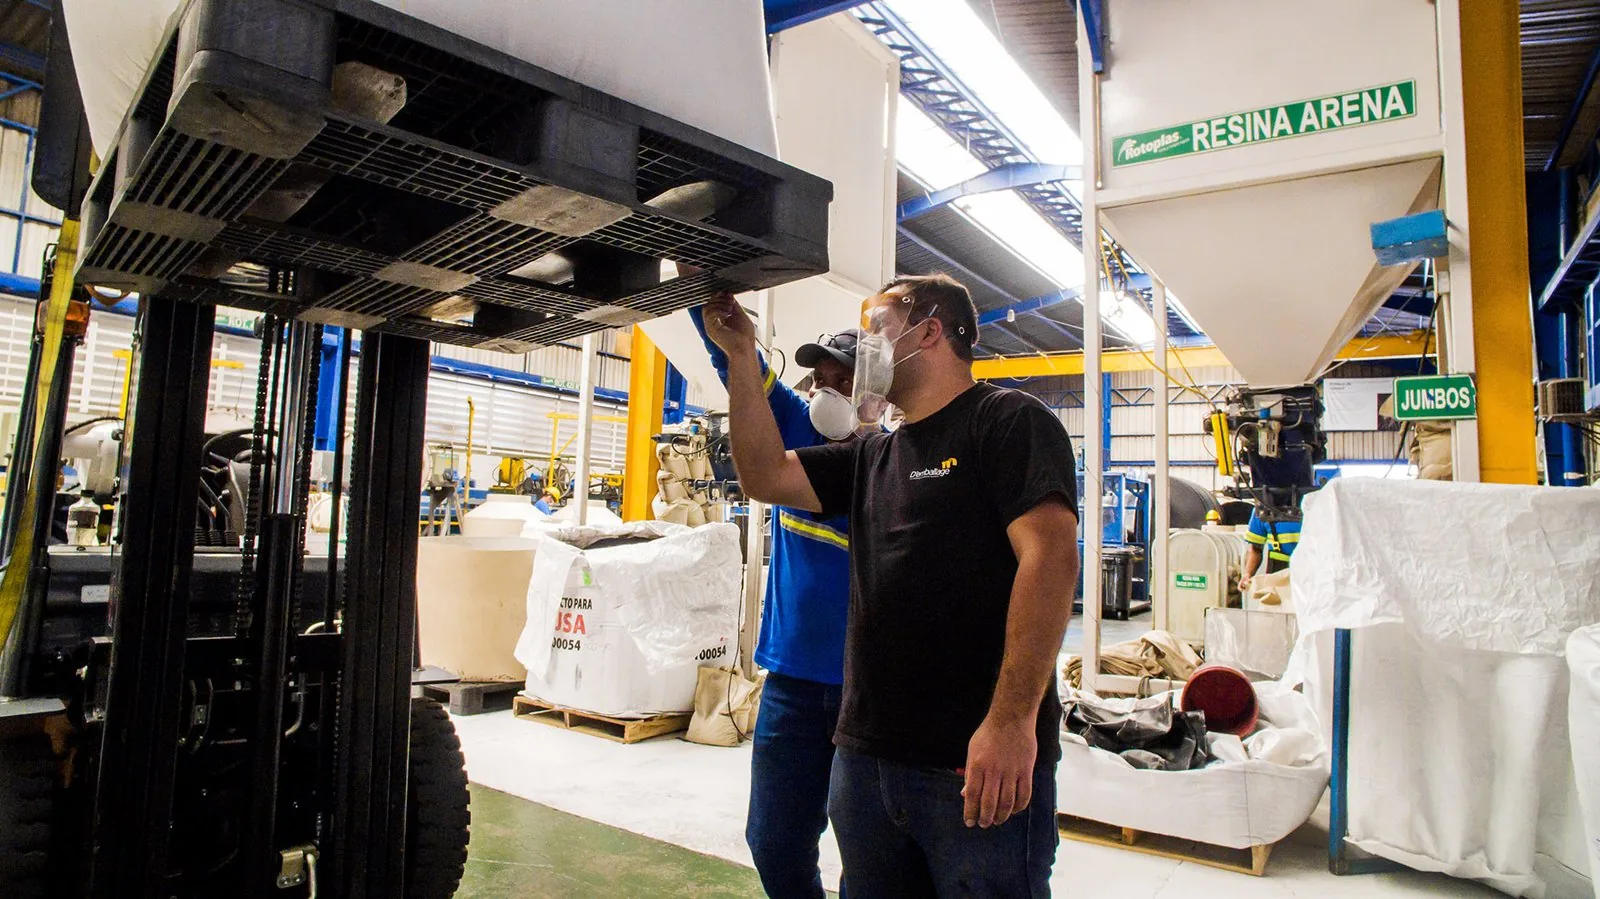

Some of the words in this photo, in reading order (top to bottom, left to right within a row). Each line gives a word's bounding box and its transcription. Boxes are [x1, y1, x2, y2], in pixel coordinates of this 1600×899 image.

[1119, 131, 1180, 160] Rotoplas
[1192, 106, 1294, 152] RESINA
[1299, 85, 1408, 133] ARENA
[1401, 387, 1471, 411] JUMBOS
[573, 598, 593, 610] PARA
[695, 645, 727, 660] 00054
